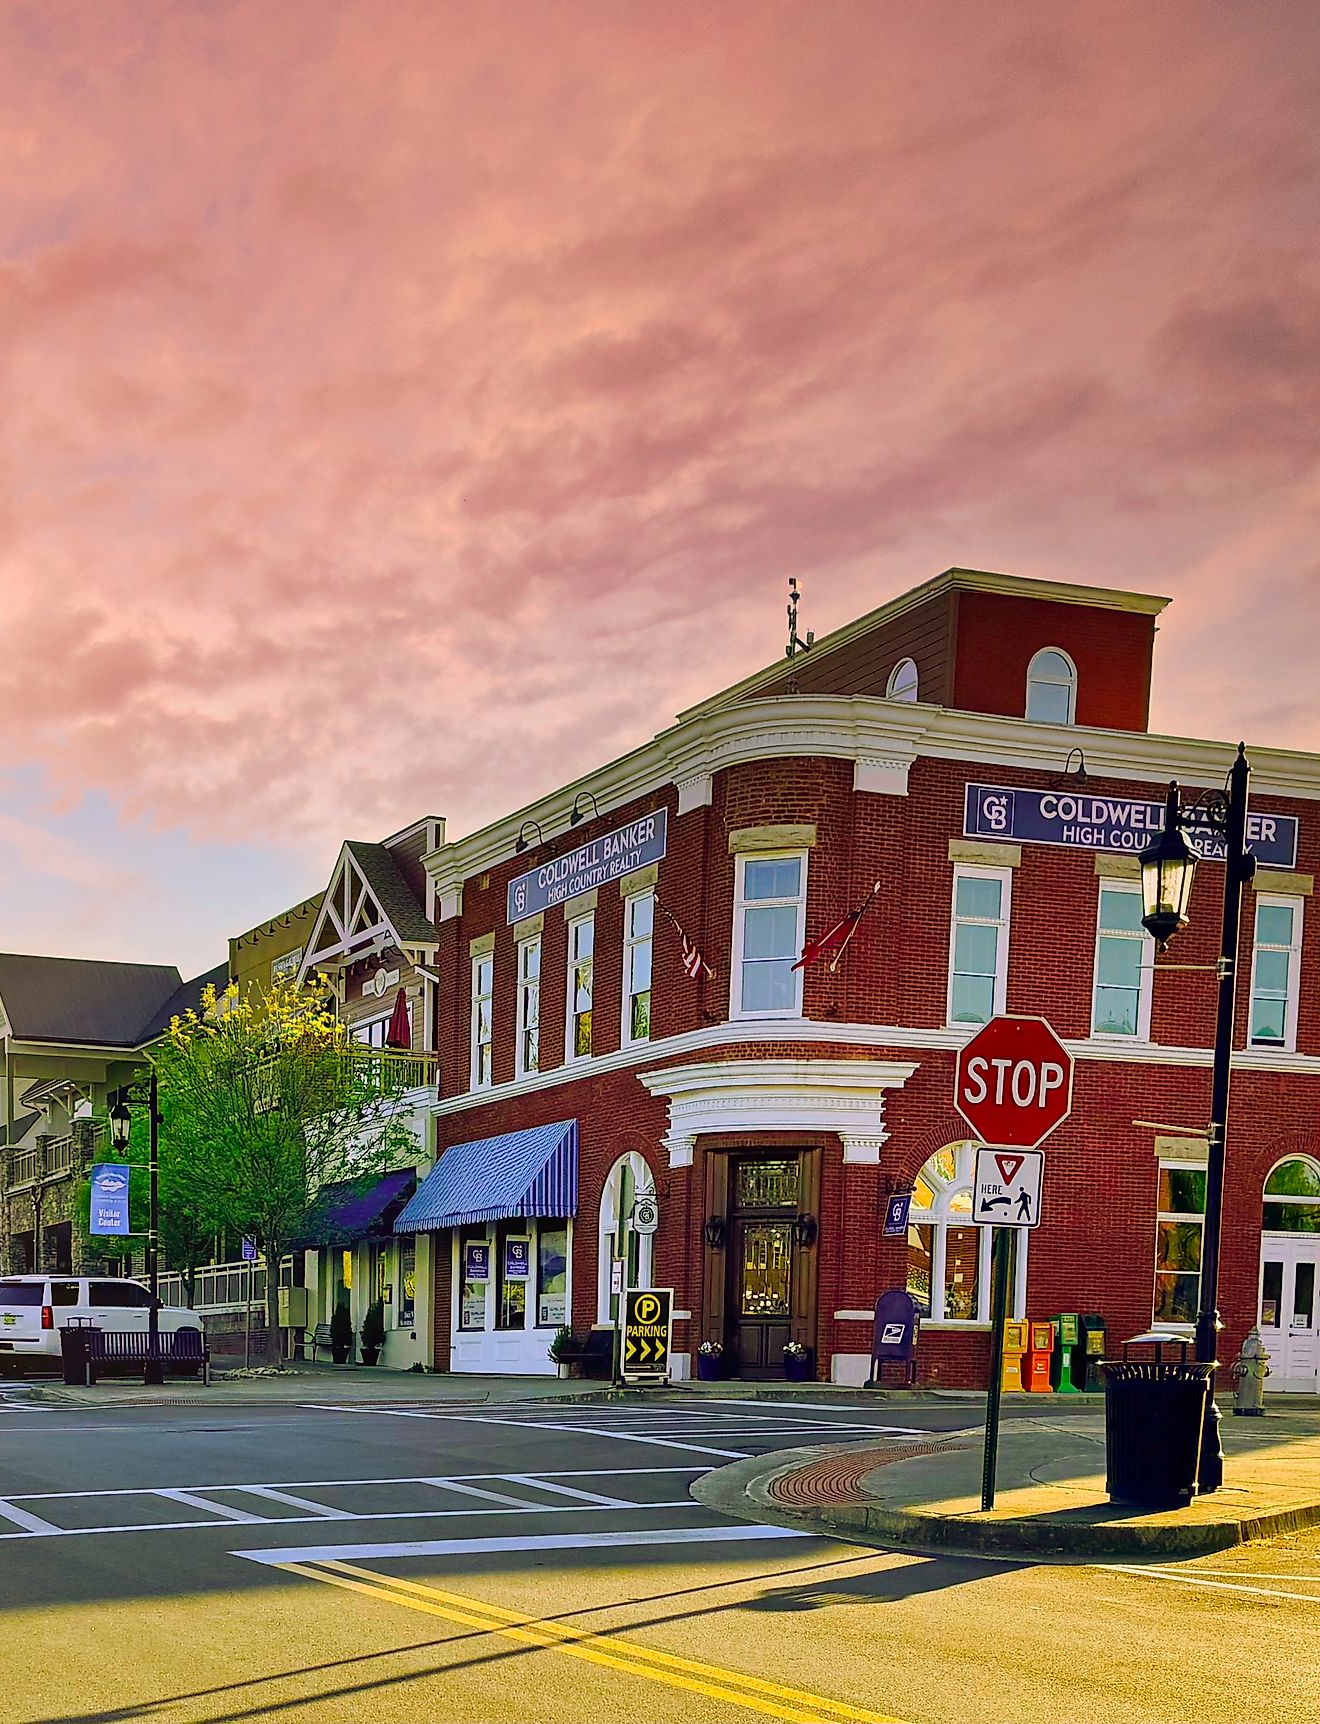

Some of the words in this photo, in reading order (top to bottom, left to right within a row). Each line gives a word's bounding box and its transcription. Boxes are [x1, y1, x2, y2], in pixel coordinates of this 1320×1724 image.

[1062, 825, 1105, 845] HIGH
[538, 845, 600, 889] COLDWELL
[603, 818, 655, 859] BANKER
[547, 882, 568, 903] HIGH
[568, 866, 608, 897] COUNTRY
[609, 848, 642, 876] REALTY
[964, 1056, 1064, 1108] STOP
[981, 1183, 1002, 1195] HERE
[98, 1208, 121, 1217] Visitor
[98, 1217, 121, 1226] Center
[642, 1300, 655, 1318] P
[626, 1325, 667, 1337] PARKING
